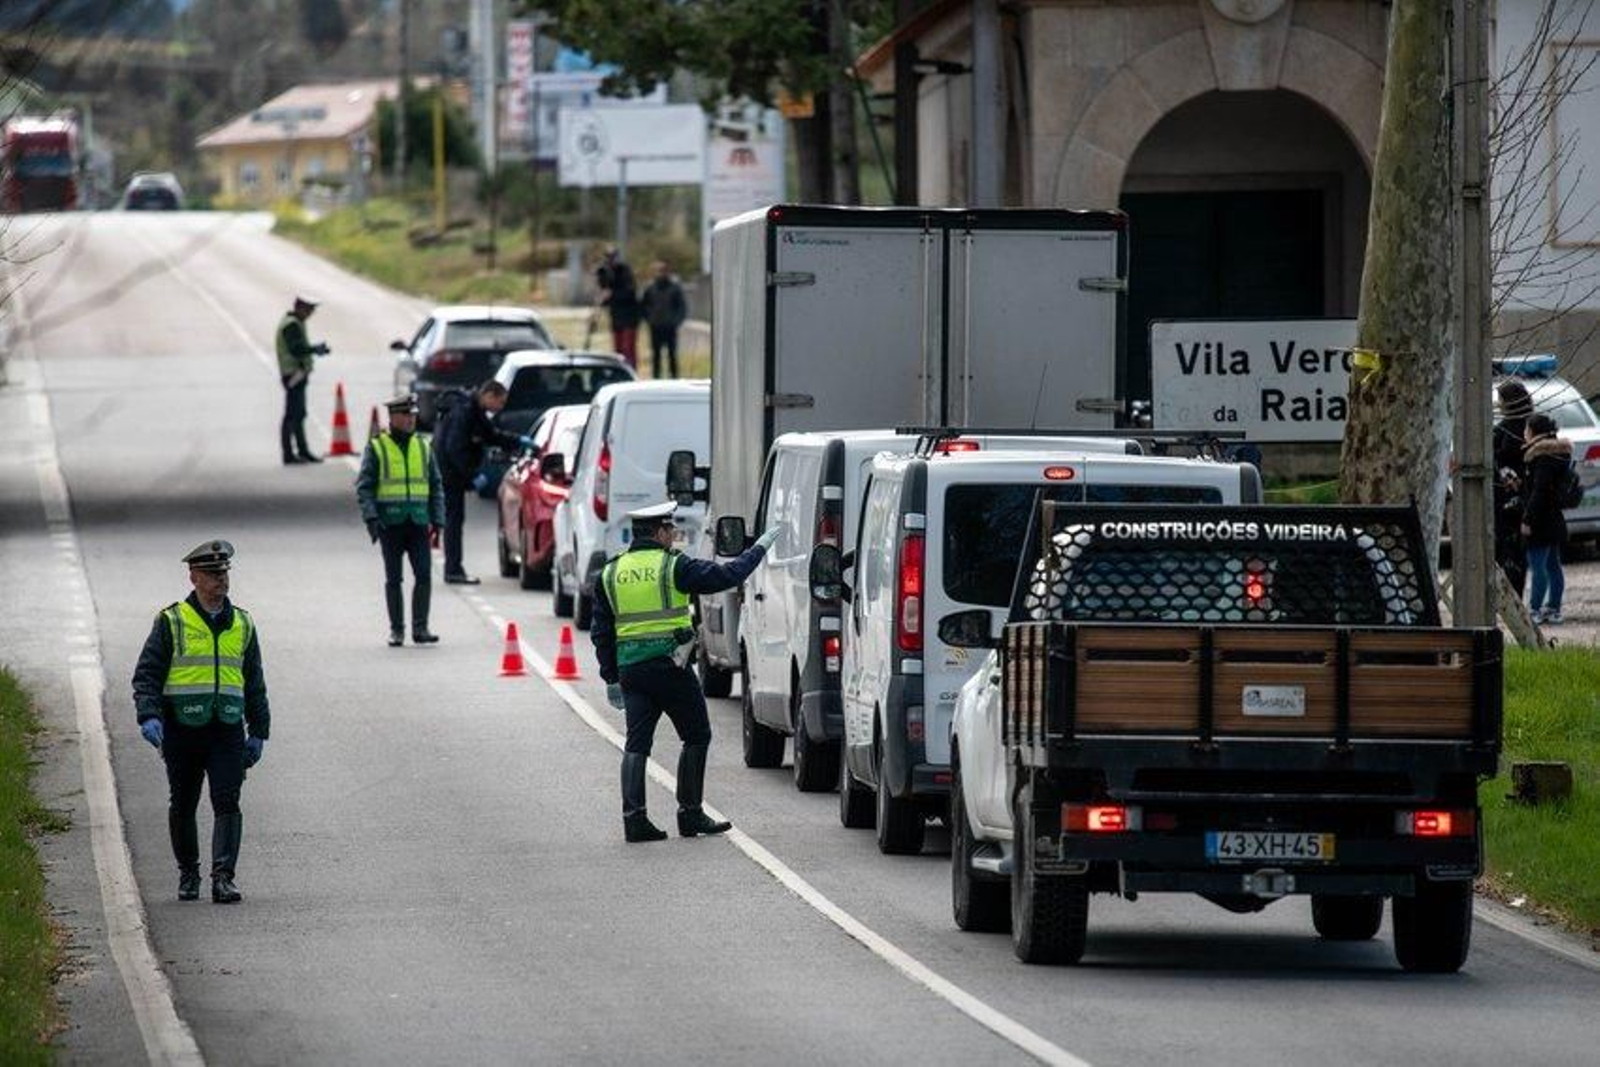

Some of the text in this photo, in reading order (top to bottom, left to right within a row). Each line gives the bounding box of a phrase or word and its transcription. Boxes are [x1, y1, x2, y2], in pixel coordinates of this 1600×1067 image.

[1174, 342, 1250, 375] Vila
[1213, 388, 1347, 422] da Raia
[1100, 520, 1347, 542] CONSTRUÇÕES VIDEIRA
[616, 567, 657, 585] GNR
